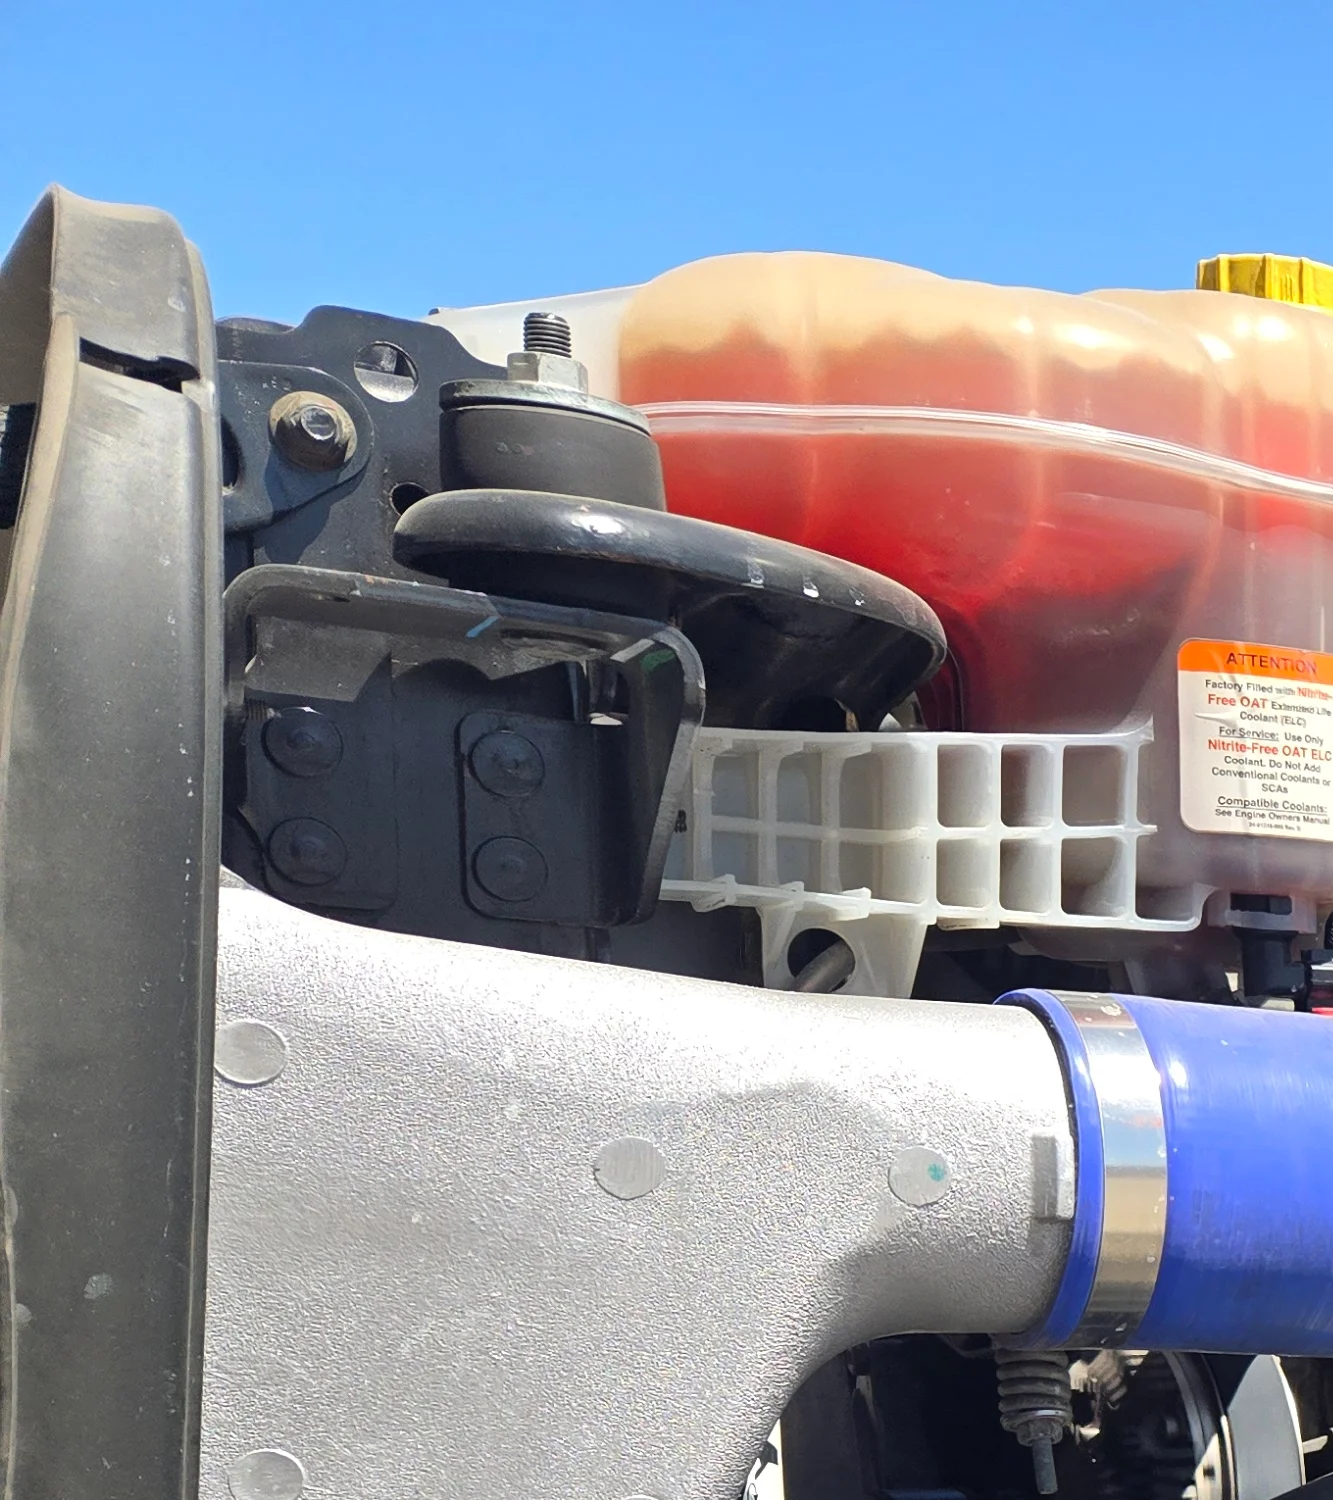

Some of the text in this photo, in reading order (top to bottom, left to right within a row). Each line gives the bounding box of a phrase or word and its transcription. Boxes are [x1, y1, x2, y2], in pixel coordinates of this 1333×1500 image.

[1226, 653, 1317, 674] ATTENTION
[1205, 680, 1243, 692] Factory
[1247, 682, 1273, 694] Filled
[1275, 686, 1295, 696] with
[1208, 694, 1236, 706] Free
[1240, 696, 1268, 709] OAT
[1317, 705, 1332, 716] Life
[1240, 712, 1306, 728] Coolant (ELC)
[1219, 727, 1324, 746] For Service: Use Only
[1208, 739, 1332, 761] Nitrite-Free OAT ELC
[1224, 756, 1321, 773] Coolant. Do Not Add
[1212, 767, 1278, 781] Conventional
[1281, 772, 1320, 784] Coolants
[1262, 784, 1288, 793] SCAs
[1218, 796, 1327, 813] Compatible Coolants:
[1215, 809, 1330, 825] See Engine Owners Manual
